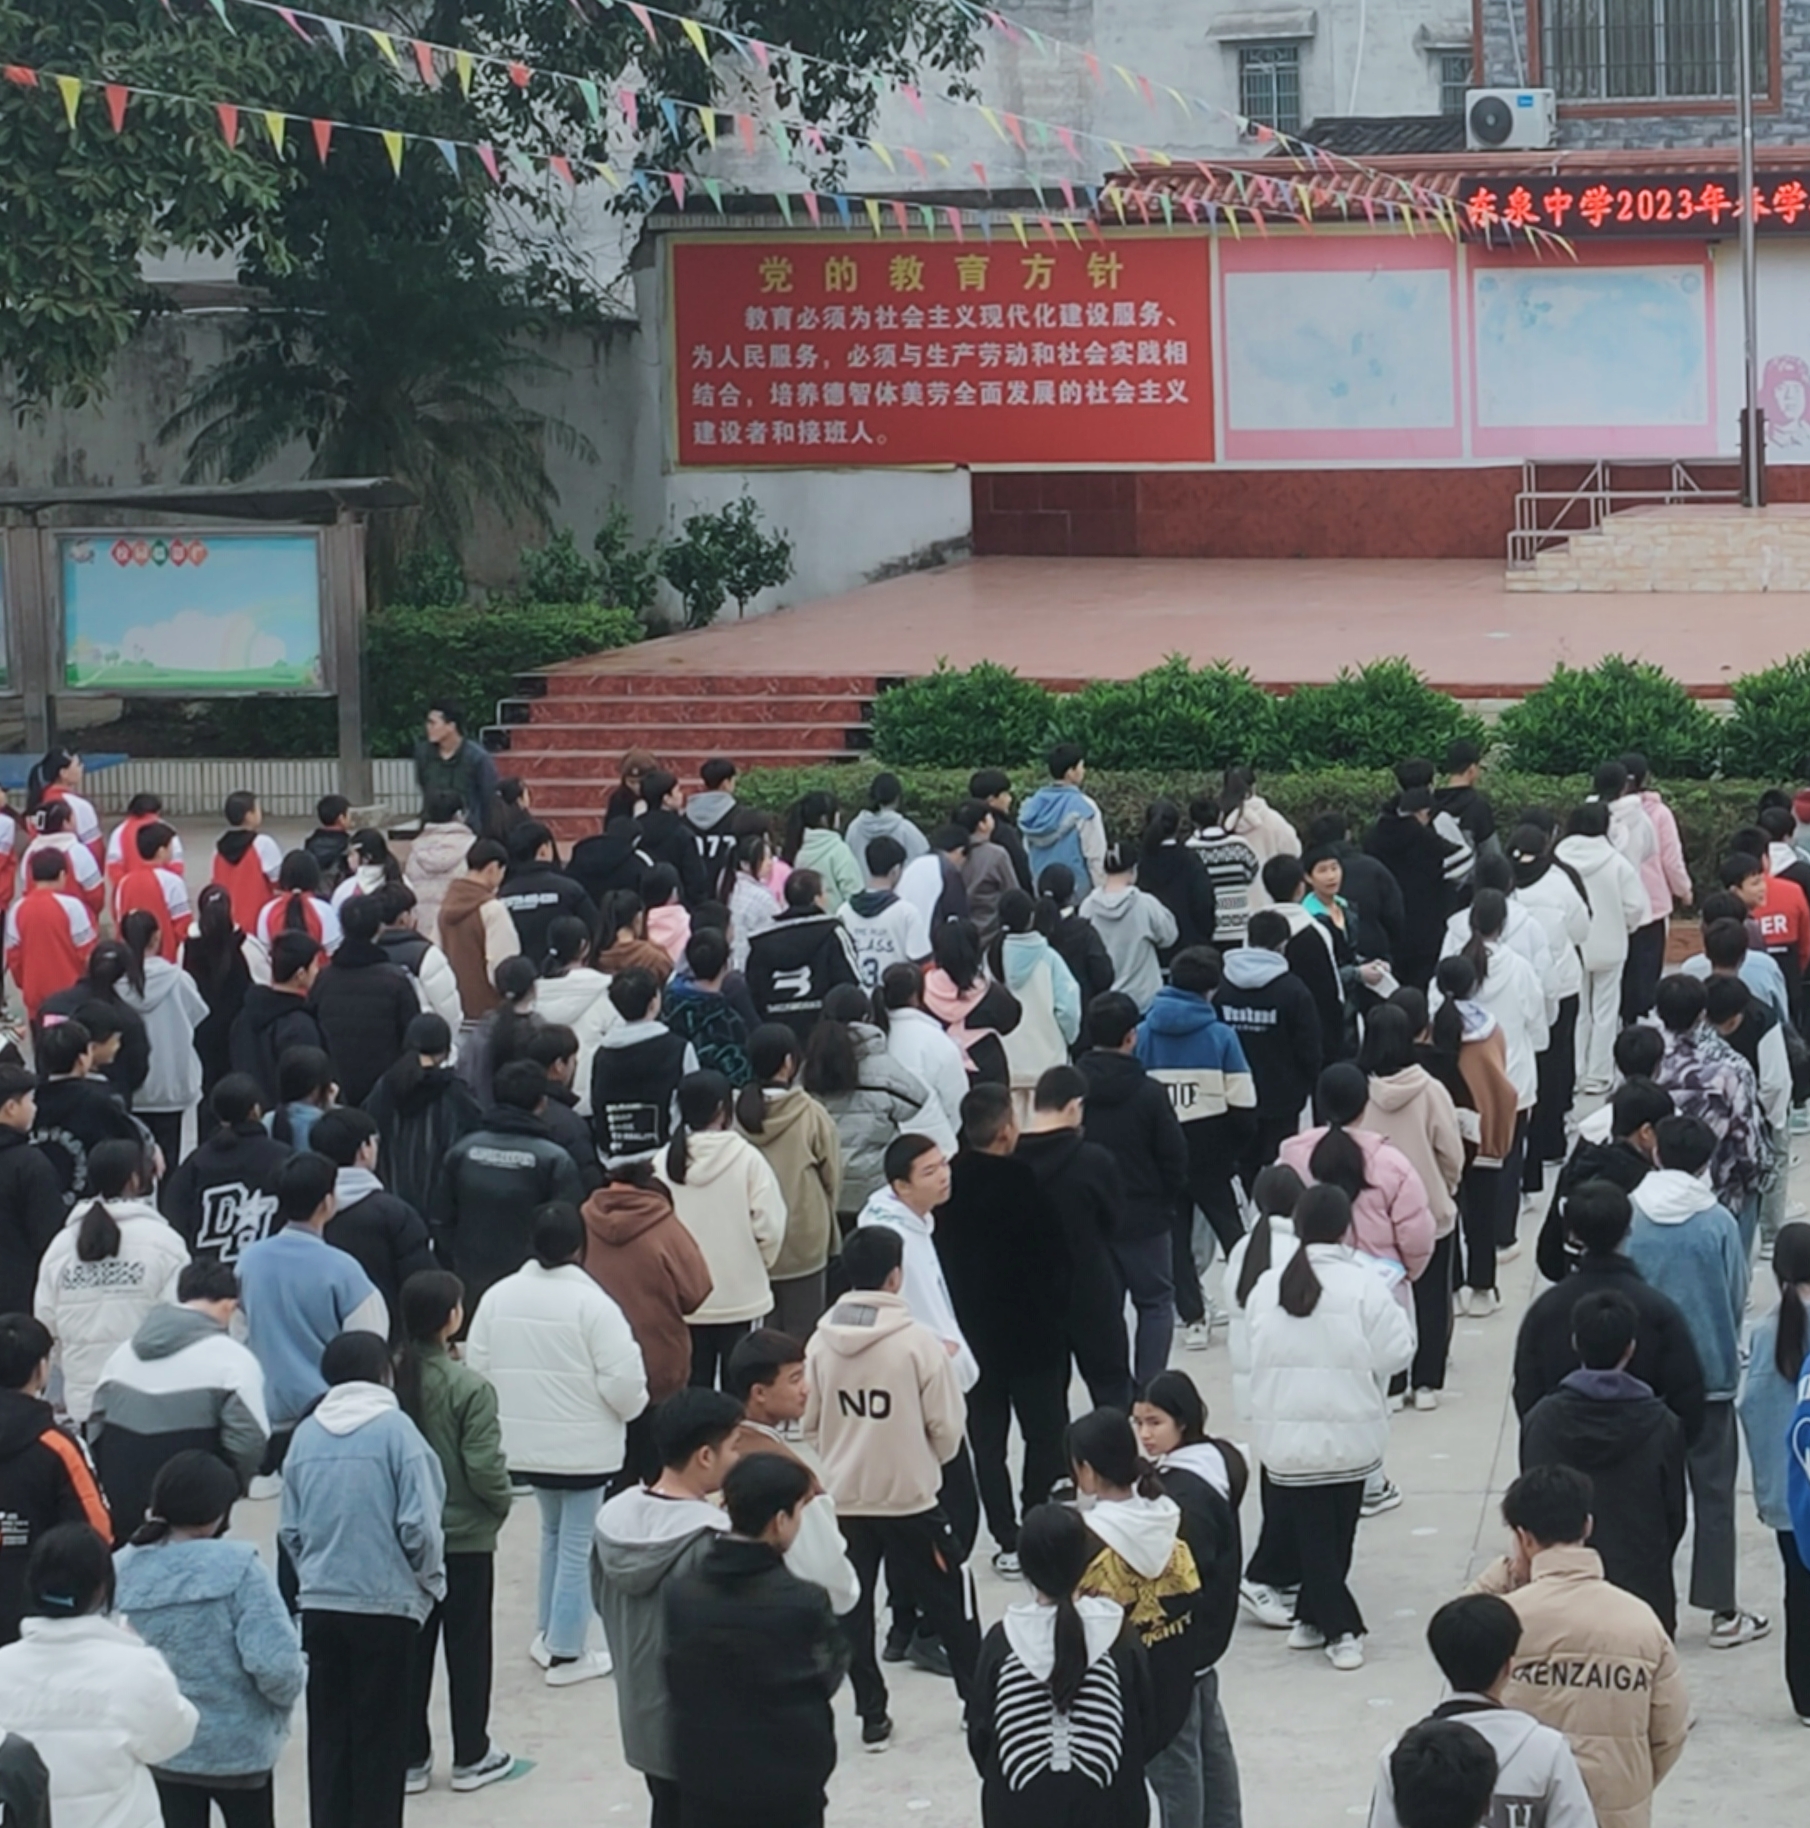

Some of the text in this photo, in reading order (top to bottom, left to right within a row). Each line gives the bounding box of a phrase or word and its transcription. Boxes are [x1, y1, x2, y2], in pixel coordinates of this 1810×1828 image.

[759, 252, 1124, 293] 党的教育方针
[744, 301, 1180, 331] 教育必须为社会主义现代化建设服务、
[691, 338, 1189, 369] 为人民服务，必须与生产劳动和社会实践相
[692, 379, 1189, 407] 结合，培养德智体美劳全面发展的社会主义
[692, 418, 888, 446] 建设者和接班人。
[838, 1388, 892, 1419] NO
